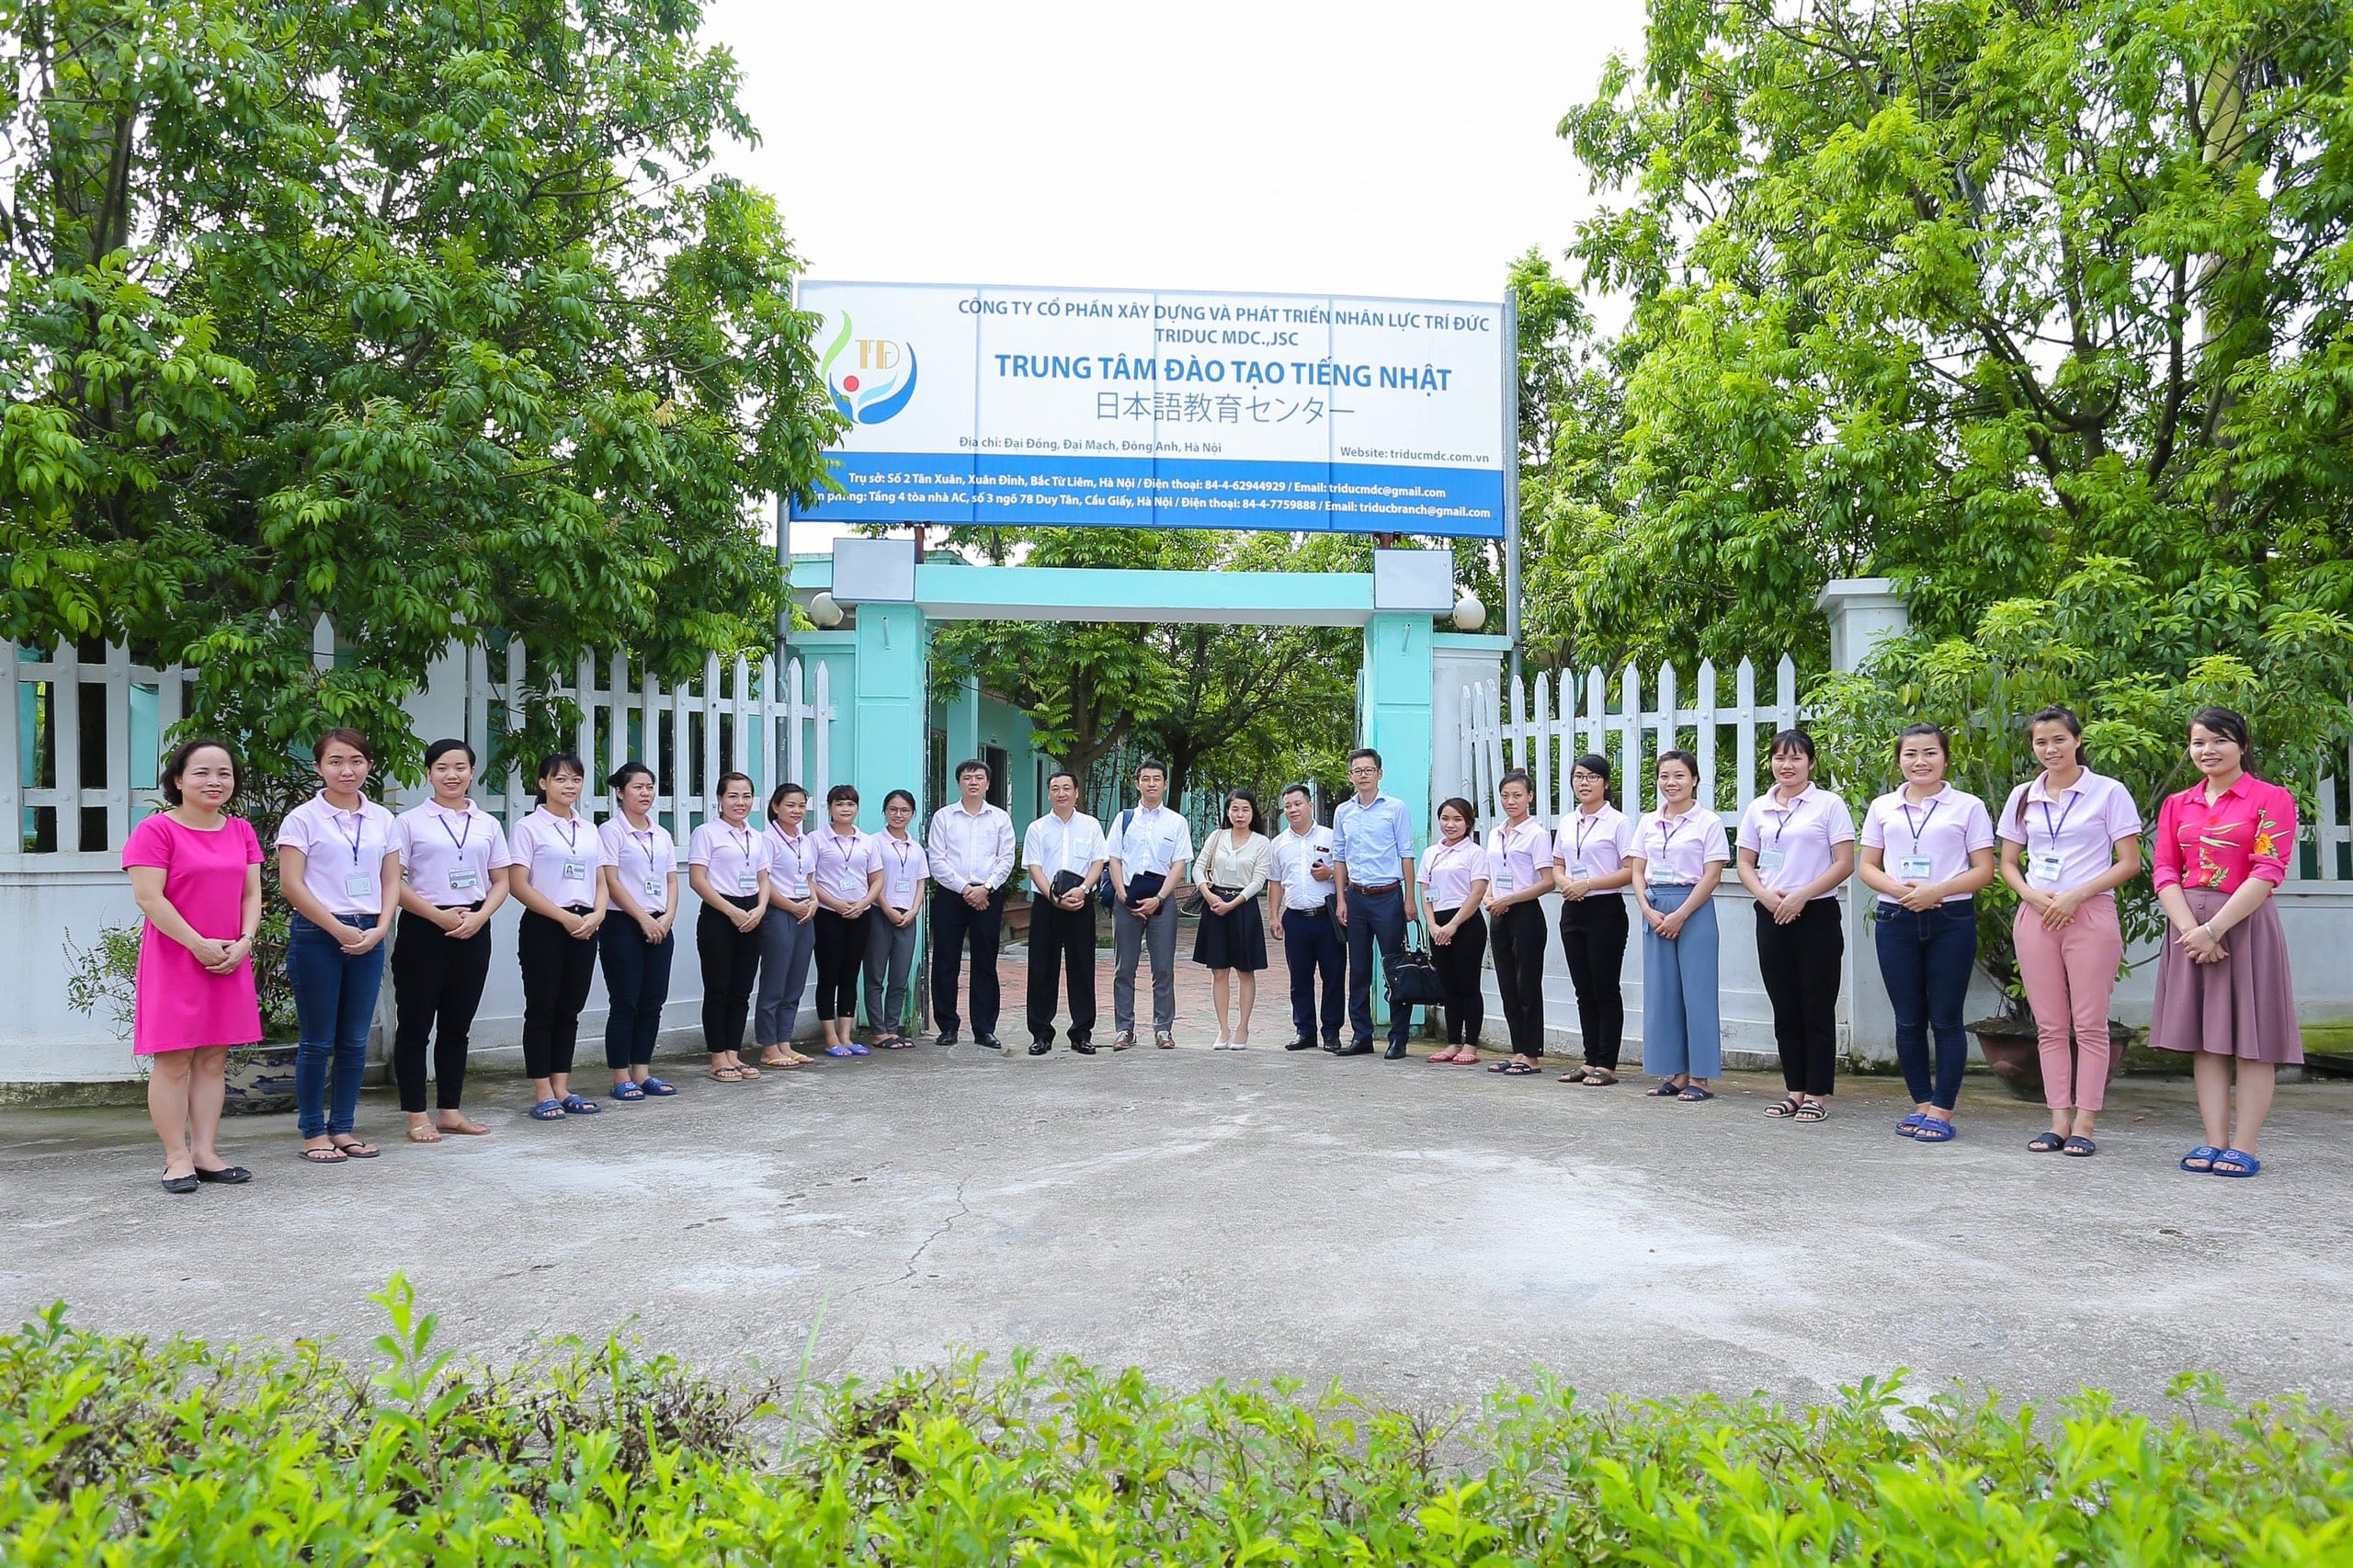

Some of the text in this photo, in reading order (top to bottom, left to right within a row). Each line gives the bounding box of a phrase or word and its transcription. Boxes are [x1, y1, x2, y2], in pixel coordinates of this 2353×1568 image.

[959, 297, 1007, 314] CÔNG
[1011, 301, 1032, 315] TY
[1038, 297, 1061, 316] CỔ
[1119, 302, 1149, 318] XÂY
[1154, 304, 1205, 324] DỰNG
[1210, 304, 1231, 321] VÀ
[1236, 305, 1279, 322] PHÁT
[1282, 305, 1330, 324] TRIỂN
[1336, 309, 1383, 326] NHÂN
[1389, 312, 1420, 331] LỰC
[1425, 313, 1449, 329] TRÍ
[1453, 314, 1489, 332] ĐỨC
[1154, 328, 1299, 347] TRIDUC MDC.,JSC
[995, 353, 1452, 397] TRUNG TÂM ĐÀO TẠO TIẾNG NHẬT
[1097, 391, 1355, 425] 日本語教育センター
[960, 437, 978, 449] Địa
[982, 437, 1002, 448] chỉ:
[1005, 437, 1023, 450] Đại
[1063, 439, 1082, 452] Đại
[1086, 439, 1119, 452] Mạch,
[1122, 440, 1153, 453] Đông
[1155, 441, 1181, 453] Anh,
[1185, 442, 1199, 452] Hà
[1203, 442, 1222, 455] Nội
[1340, 446, 1490, 463] Website: triducmdc.com.vn
[848, 472, 867, 485] Trụ
[870, 472, 885, 483] sở:
[887, 472, 902, 483] Số
[904, 473, 911, 483] 2
[913, 473, 932, 484] Tân
[935, 474, 965, 485] Xuân,
[968, 474, 996, 485] Xuân
[1030, 474, 1050, 486] Bắc
[1051, 475, 1066, 487] Từ
[1067, 476, 1097, 489] Liêm,
[1099, 477, 1113, 488] Hà
[1117, 477, 1135, 491] Nội
[1137, 478, 1142, 489] /
[1143, 478, 1168, 492] Điện
[1171, 479, 1202, 492] thoại:
[1205, 480, 1286, 492] 84-4-62944929
[1288, 482, 1292, 493] /
[1294, 482, 1327, 494] Email:
[1329, 483, 1446, 498] triducmdc@gmail.com
[827, 493, 867, 504] phng:
[898, 492, 904, 502] 4
[907, 492, 926, 502] tòa
[928, 492, 949, 502] nhà
[951, 492, 969, 505] AC,
[972, 492, 985, 503] số
[987, 494, 994, 503] 3
[996, 493, 1017, 506] ngõ
[1020, 494, 1033, 504] 78
[1036, 494, 1058, 507] Duy
[1060, 494, 1082, 506] Tân,
[1108, 494, 1134, 508] Giấy,
[1137, 496, 1154, 506] Hà
[1154, 496, 1173, 509] Nội
[1175, 497, 1179, 507] /
[1181, 497, 1206, 510] Điện
[1209, 497, 1240, 511] thoại:
[1243, 498, 1316, 511] 84-4-7759888
[1318, 500, 1324, 511] /
[1324, 500, 1358, 512] Email:
[1359, 502, 1491, 518] triducbranch@gmail.com
